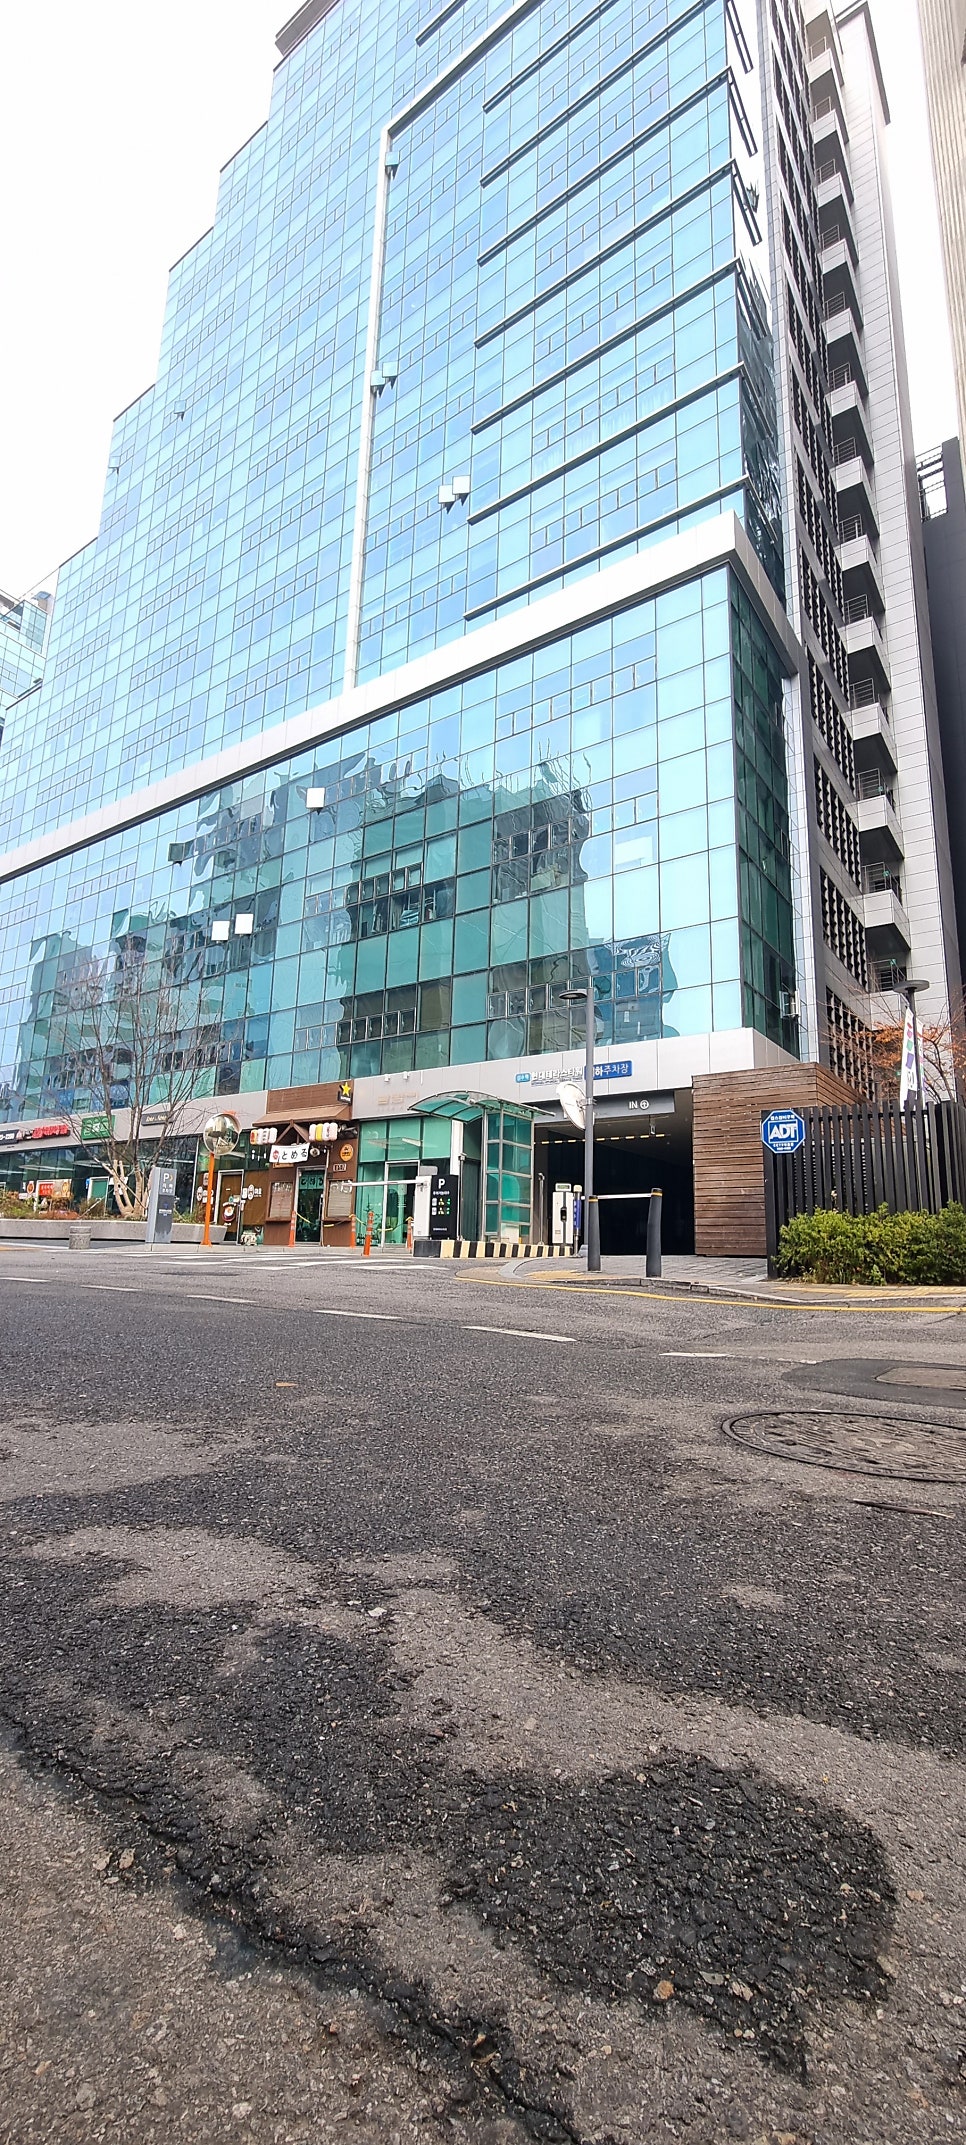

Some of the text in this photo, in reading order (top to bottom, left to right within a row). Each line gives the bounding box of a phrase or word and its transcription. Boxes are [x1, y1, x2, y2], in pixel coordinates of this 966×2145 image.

[628, 1100, 638, 1109] IN
[769, 1122, 797, 1140] ADT
[163, 1172, 170, 1182] P
[438, 1178, 446, 1189] P
